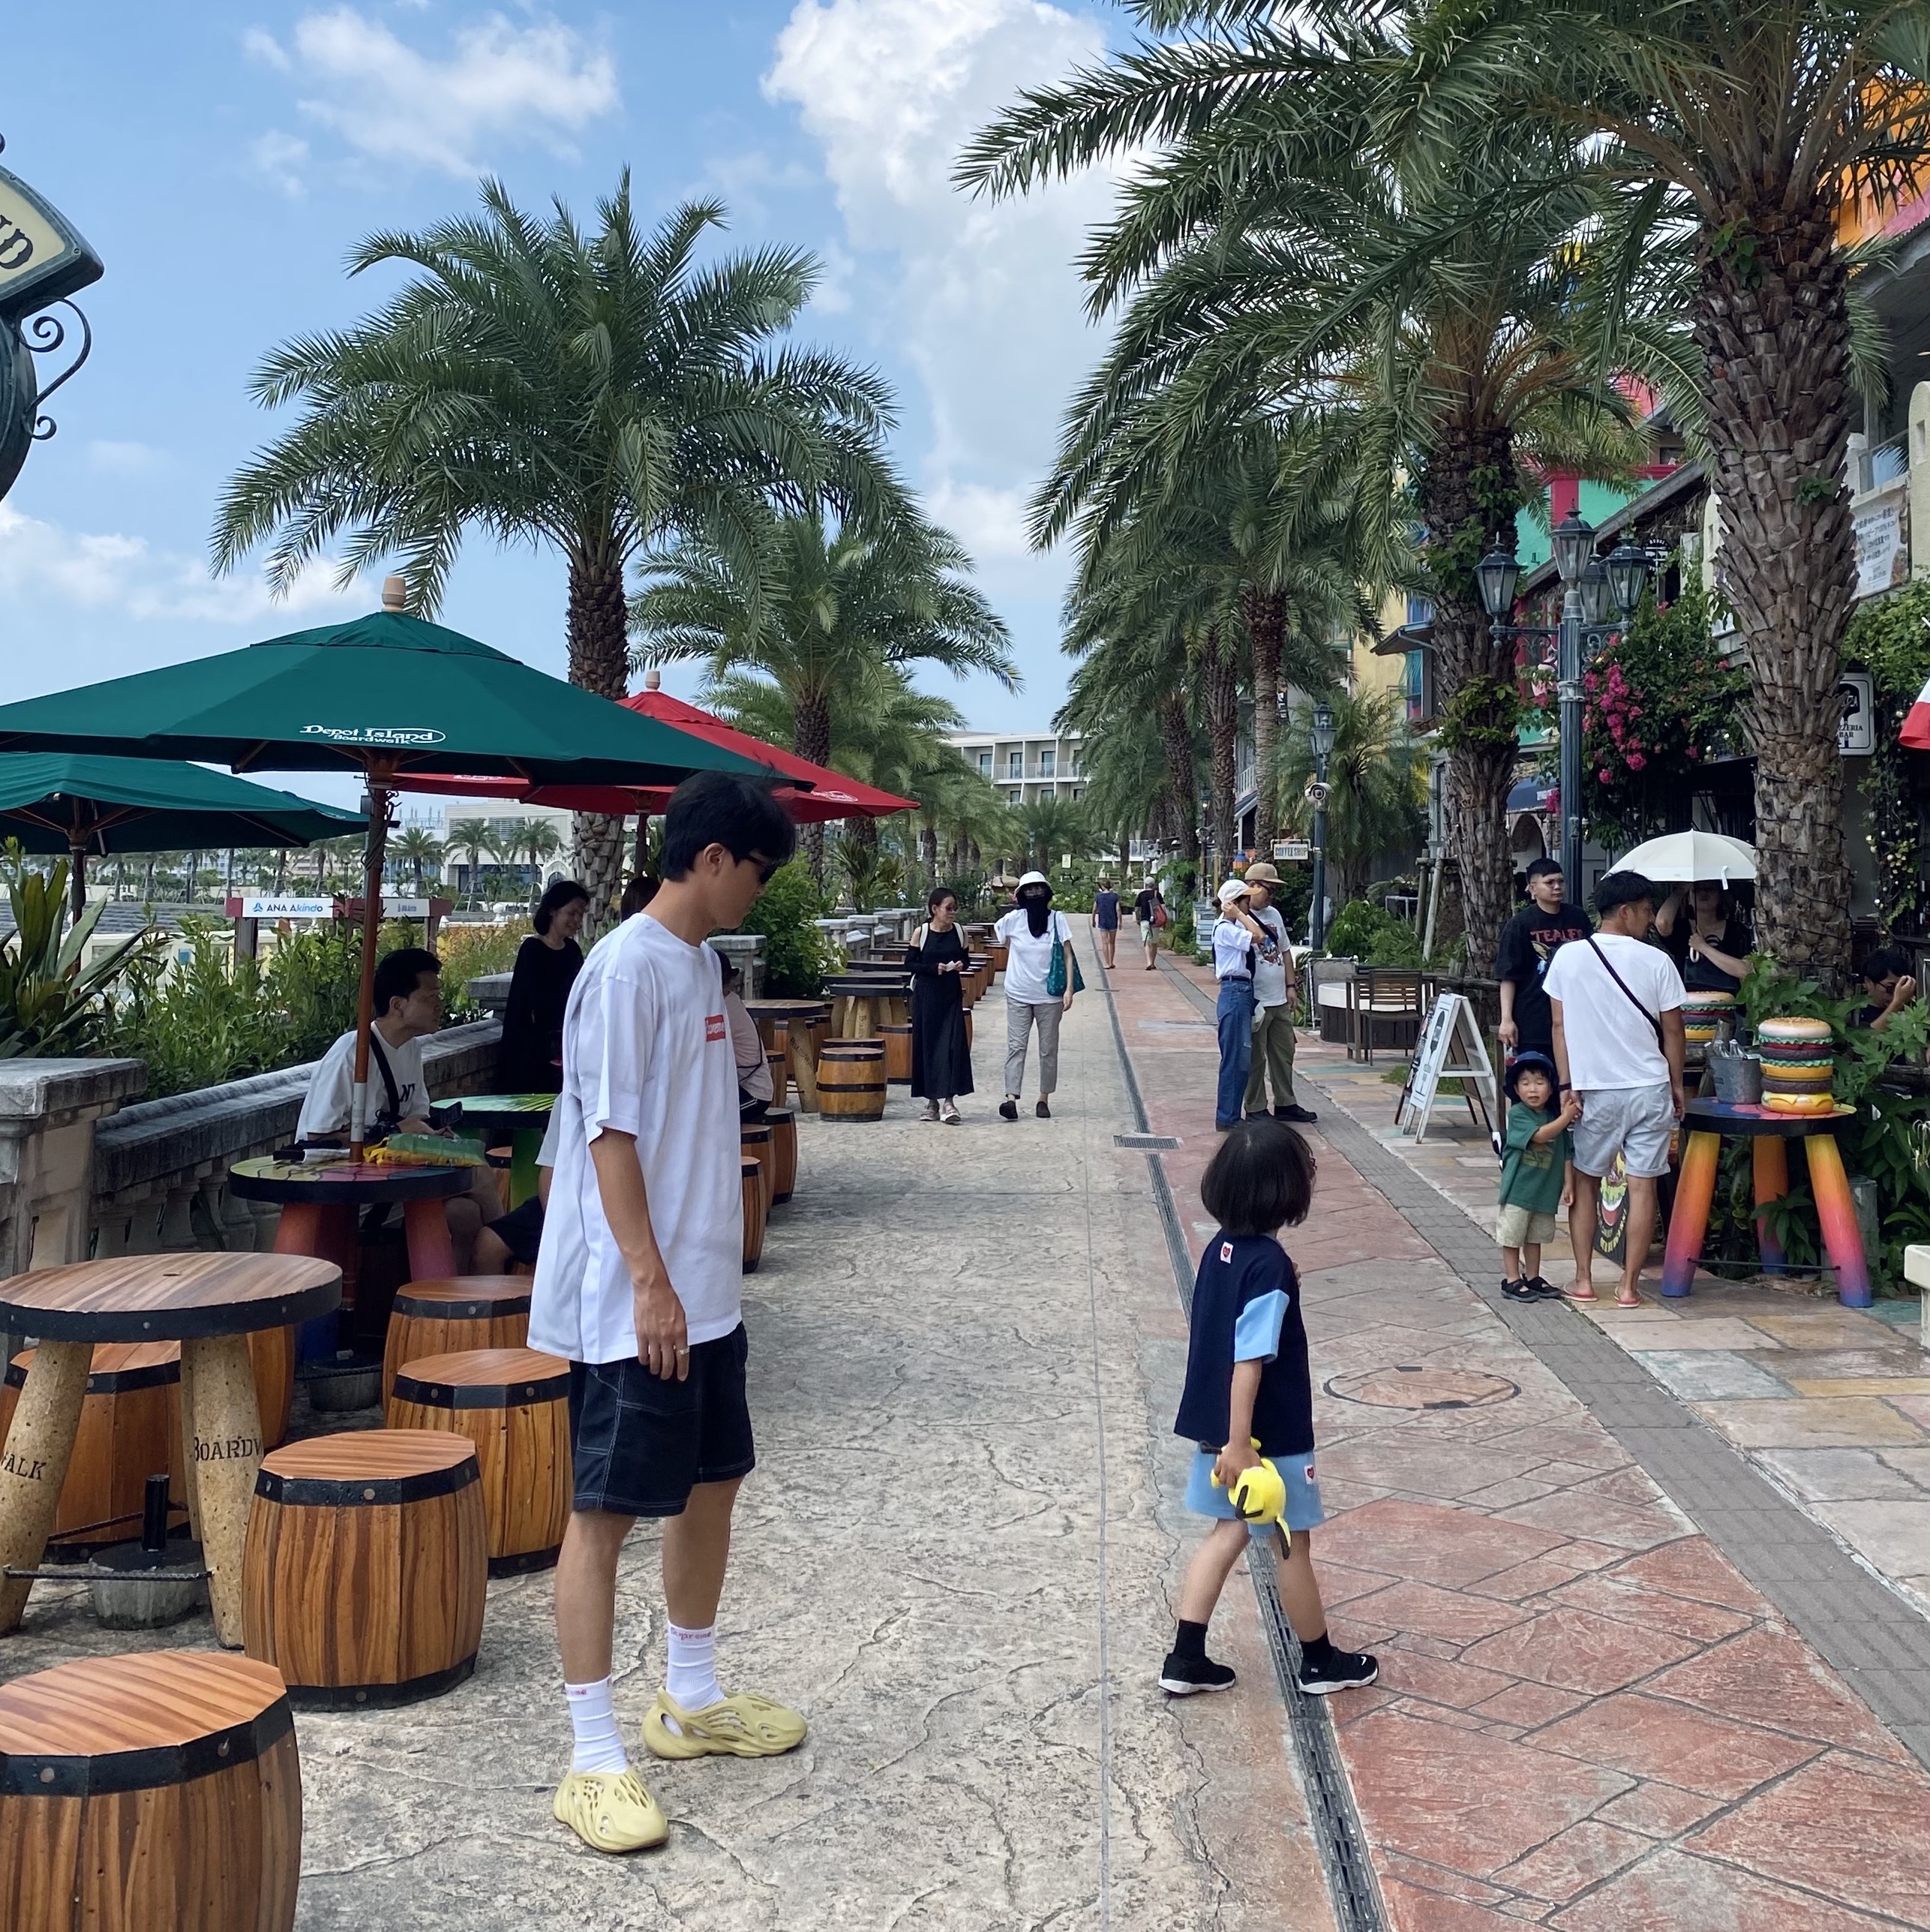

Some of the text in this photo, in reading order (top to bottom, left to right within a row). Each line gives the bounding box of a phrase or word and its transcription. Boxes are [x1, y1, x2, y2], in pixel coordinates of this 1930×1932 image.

[300, 725, 434, 741] Depot Island
[333, 735, 411, 745] Boardwalk
[266, 903, 323, 912] ANA Akindo
